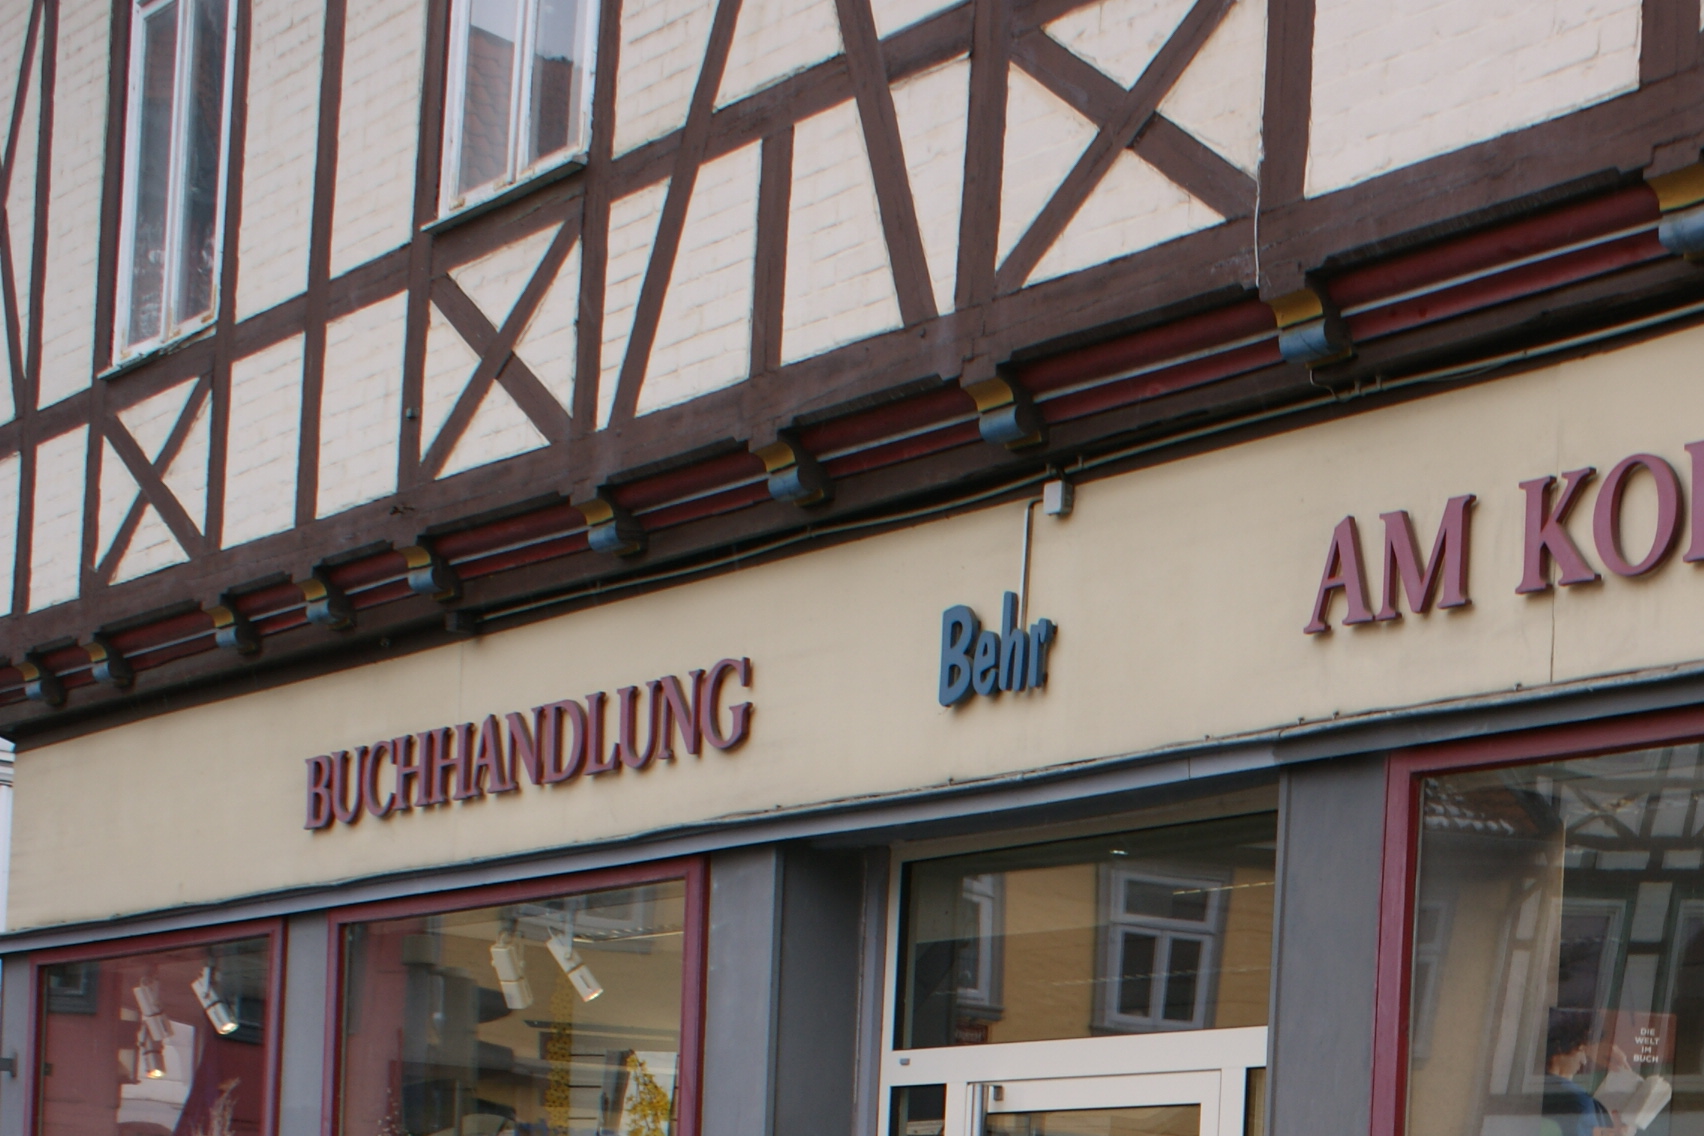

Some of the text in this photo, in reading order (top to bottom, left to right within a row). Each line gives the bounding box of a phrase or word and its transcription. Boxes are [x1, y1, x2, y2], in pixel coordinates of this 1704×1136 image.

[1304, 493, 1477, 636] AM
[939, 590, 1058, 709] Behr
[304, 657, 754, 831] BUCHHANDLUNG
[1633, 1055, 1659, 1063] BUCH
[1635, 1036, 1660, 1045] WELT
[1640, 1027, 1656, 1036] DIE
